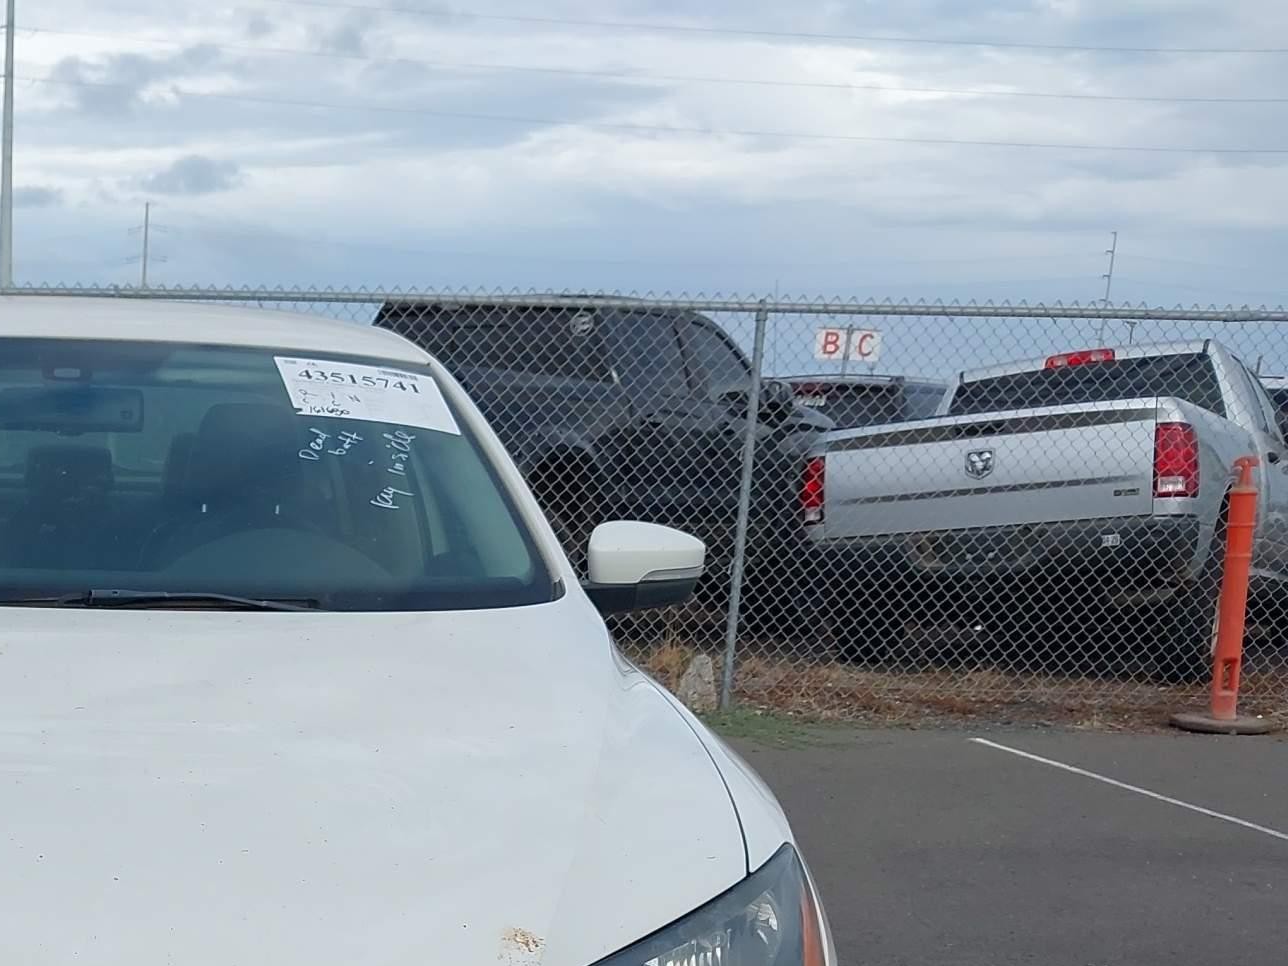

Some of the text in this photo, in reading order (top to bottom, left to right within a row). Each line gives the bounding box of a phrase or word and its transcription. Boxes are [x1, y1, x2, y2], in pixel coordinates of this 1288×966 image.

[822, 331, 874, 357] B C
[298, 368, 421, 394] 43515741
